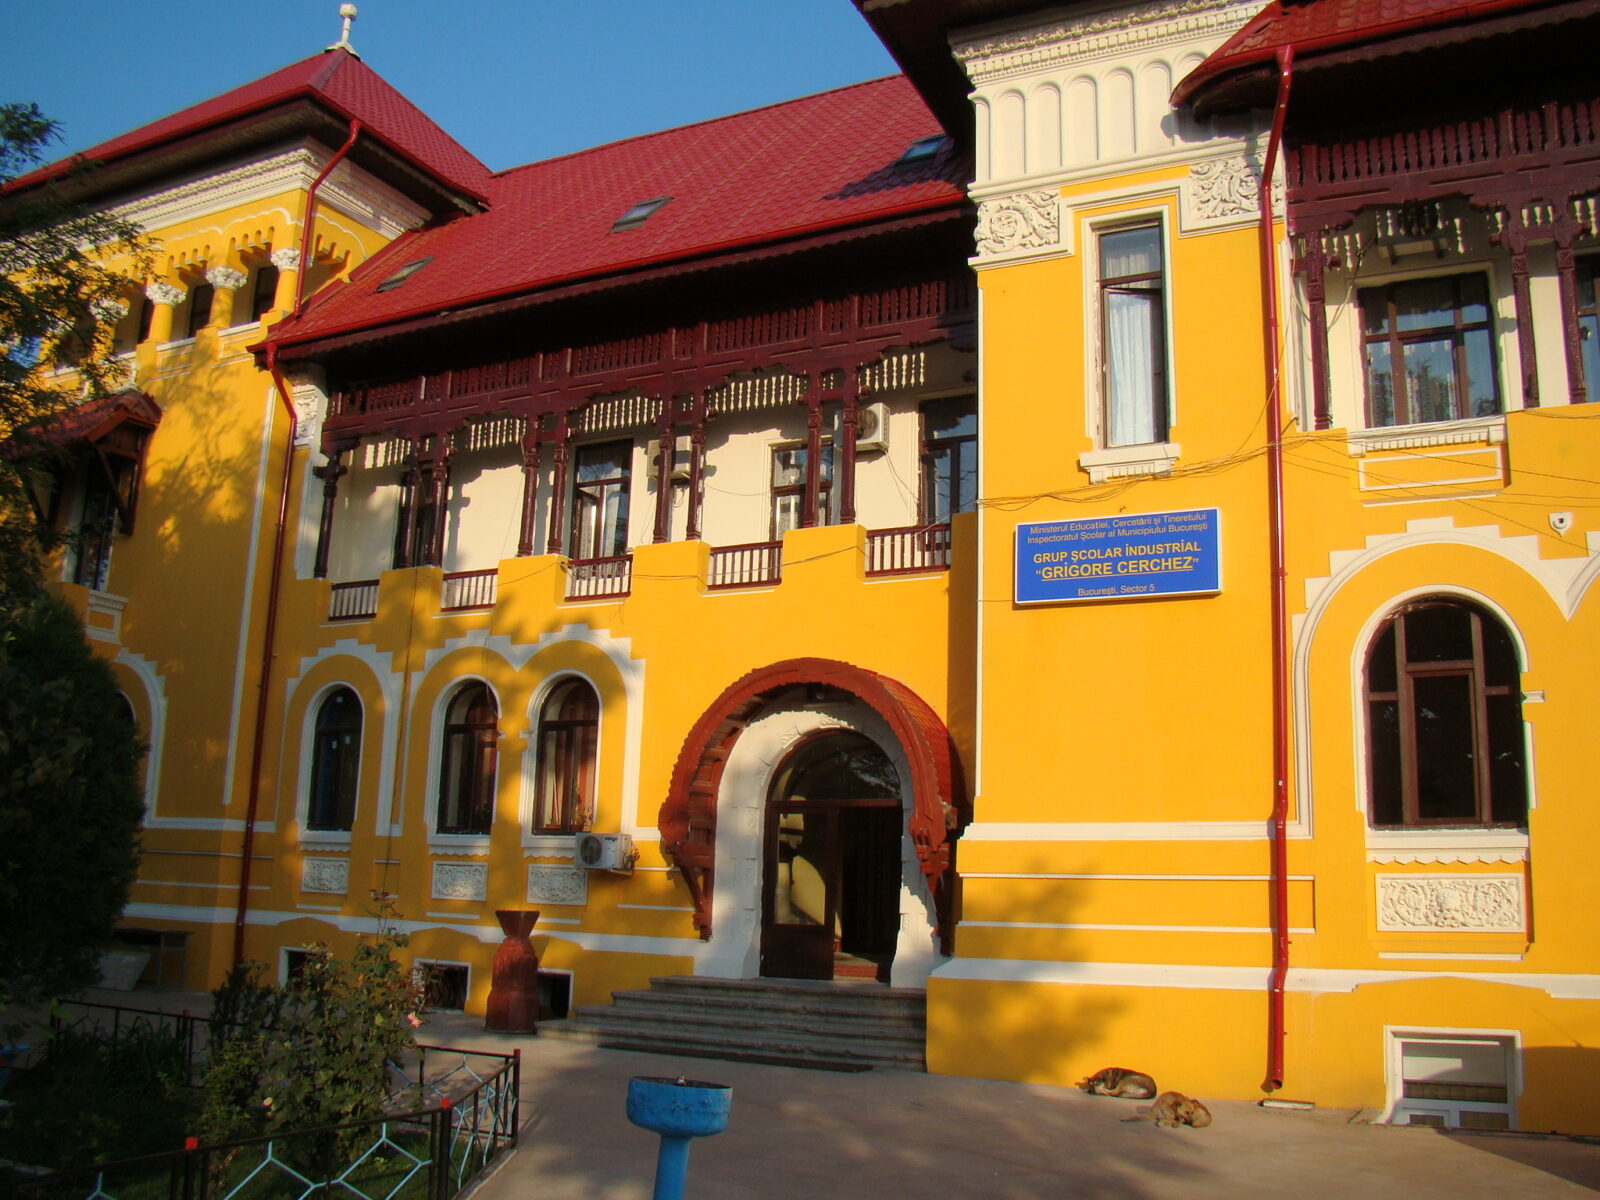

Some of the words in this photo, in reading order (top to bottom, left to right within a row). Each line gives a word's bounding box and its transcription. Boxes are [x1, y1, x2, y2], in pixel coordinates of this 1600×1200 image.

[1030, 524, 1068, 534] Ministerul
[1164, 512, 1206, 523] Tineretului
[1027, 532, 1078, 544] Inspectoratul
[1108, 529, 1115, 537] al
[1118, 526, 1166, 536] Municipiului
[1033, 551, 1068, 563] GRUP
[1120, 585, 1148, 593] Sector
[1149, 584, 1155, 592] 5
